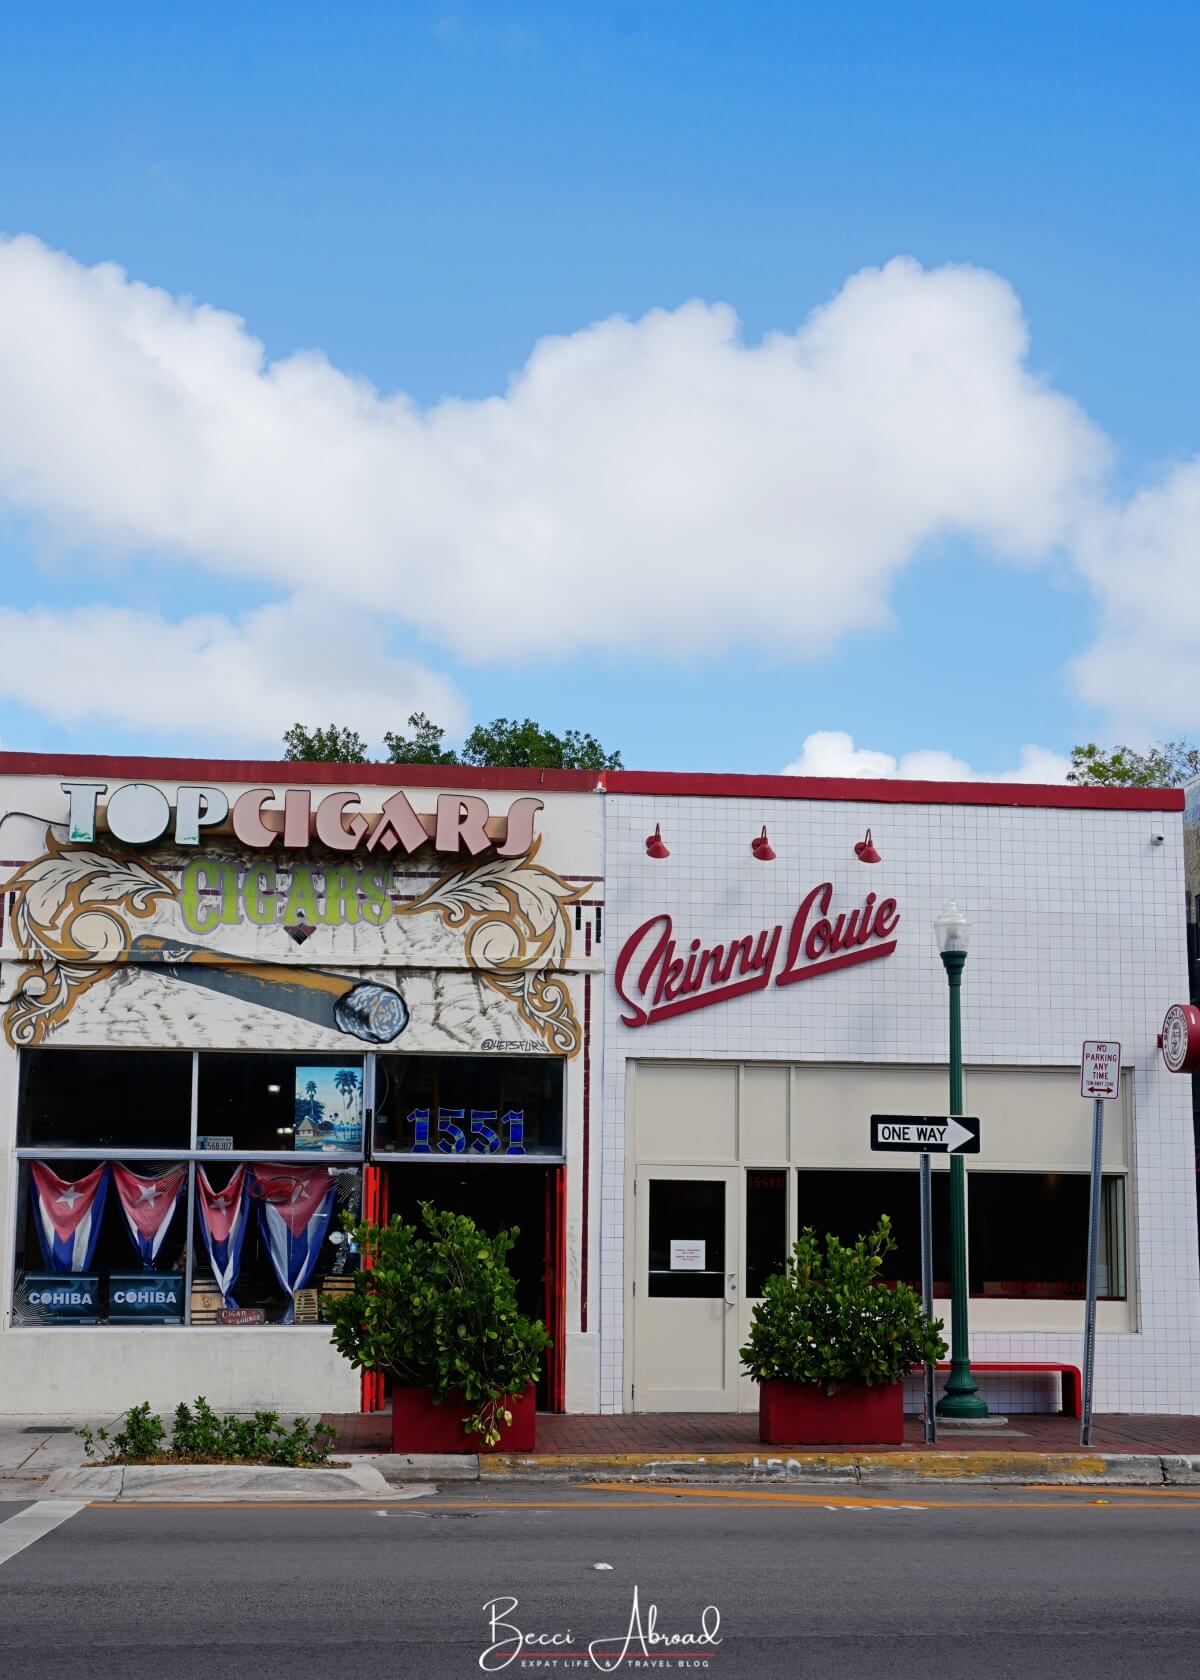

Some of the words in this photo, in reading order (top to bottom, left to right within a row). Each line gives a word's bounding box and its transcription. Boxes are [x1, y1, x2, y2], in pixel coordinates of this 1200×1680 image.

[233, 788, 545, 857] CIGARS
[179, 858, 395, 936] CIGARS
[615, 913, 783, 1027] Skinny
[775, 881, 900, 986] Louie
[1096, 1044, 1107, 1053] NO
[1085, 1053, 1117, 1063] PARKING
[1093, 1062, 1108, 1071] ANY
[1092, 1071, 1109, 1080] TIME
[406, 1107, 527, 1155] 1551
[880, 1125, 912, 1142] ONE
[916, 1125, 947, 1143] WAY
[28, 1292, 93, 1305] COHIBA
[114, 1291, 177, 1303] COHIBA
